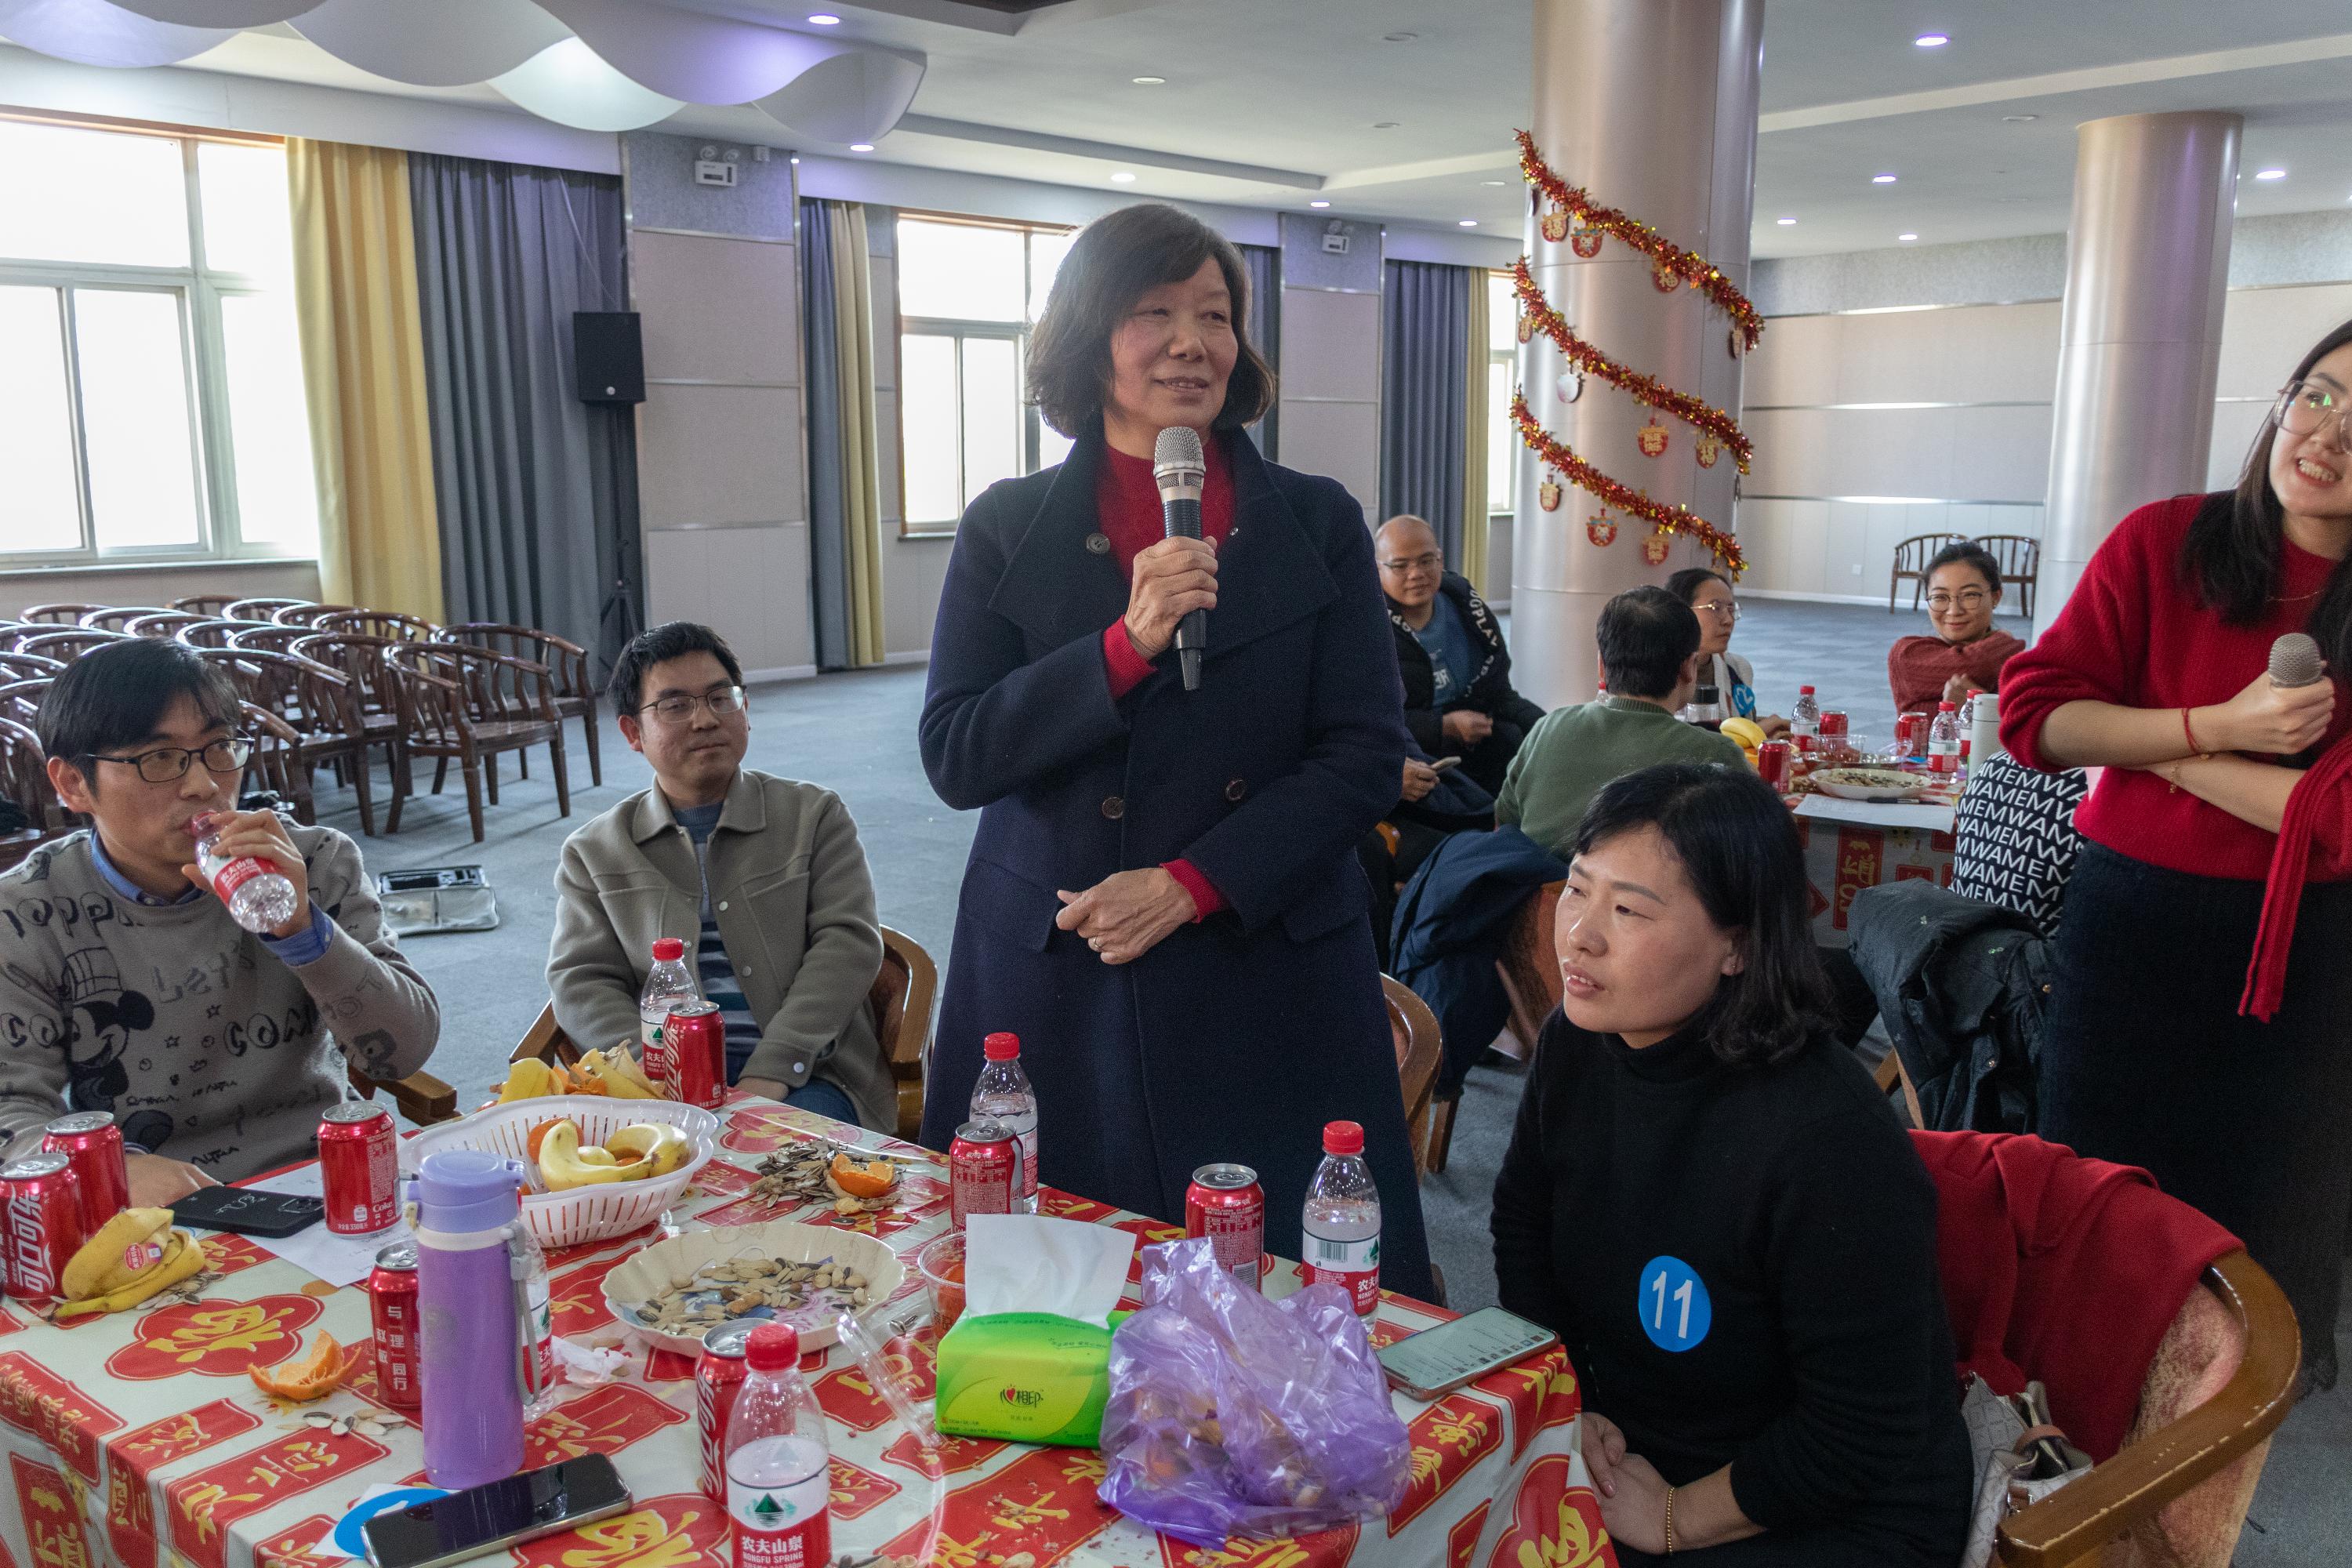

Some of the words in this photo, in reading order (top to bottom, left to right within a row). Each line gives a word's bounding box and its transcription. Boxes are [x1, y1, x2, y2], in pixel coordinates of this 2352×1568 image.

[1651, 1270, 1693, 1339] 11
[742, 1534, 803, 1554] 农夫山泉
[742, 1552, 771, 1563] NONGFU
[774, 1552, 803, 1563] SPRING
